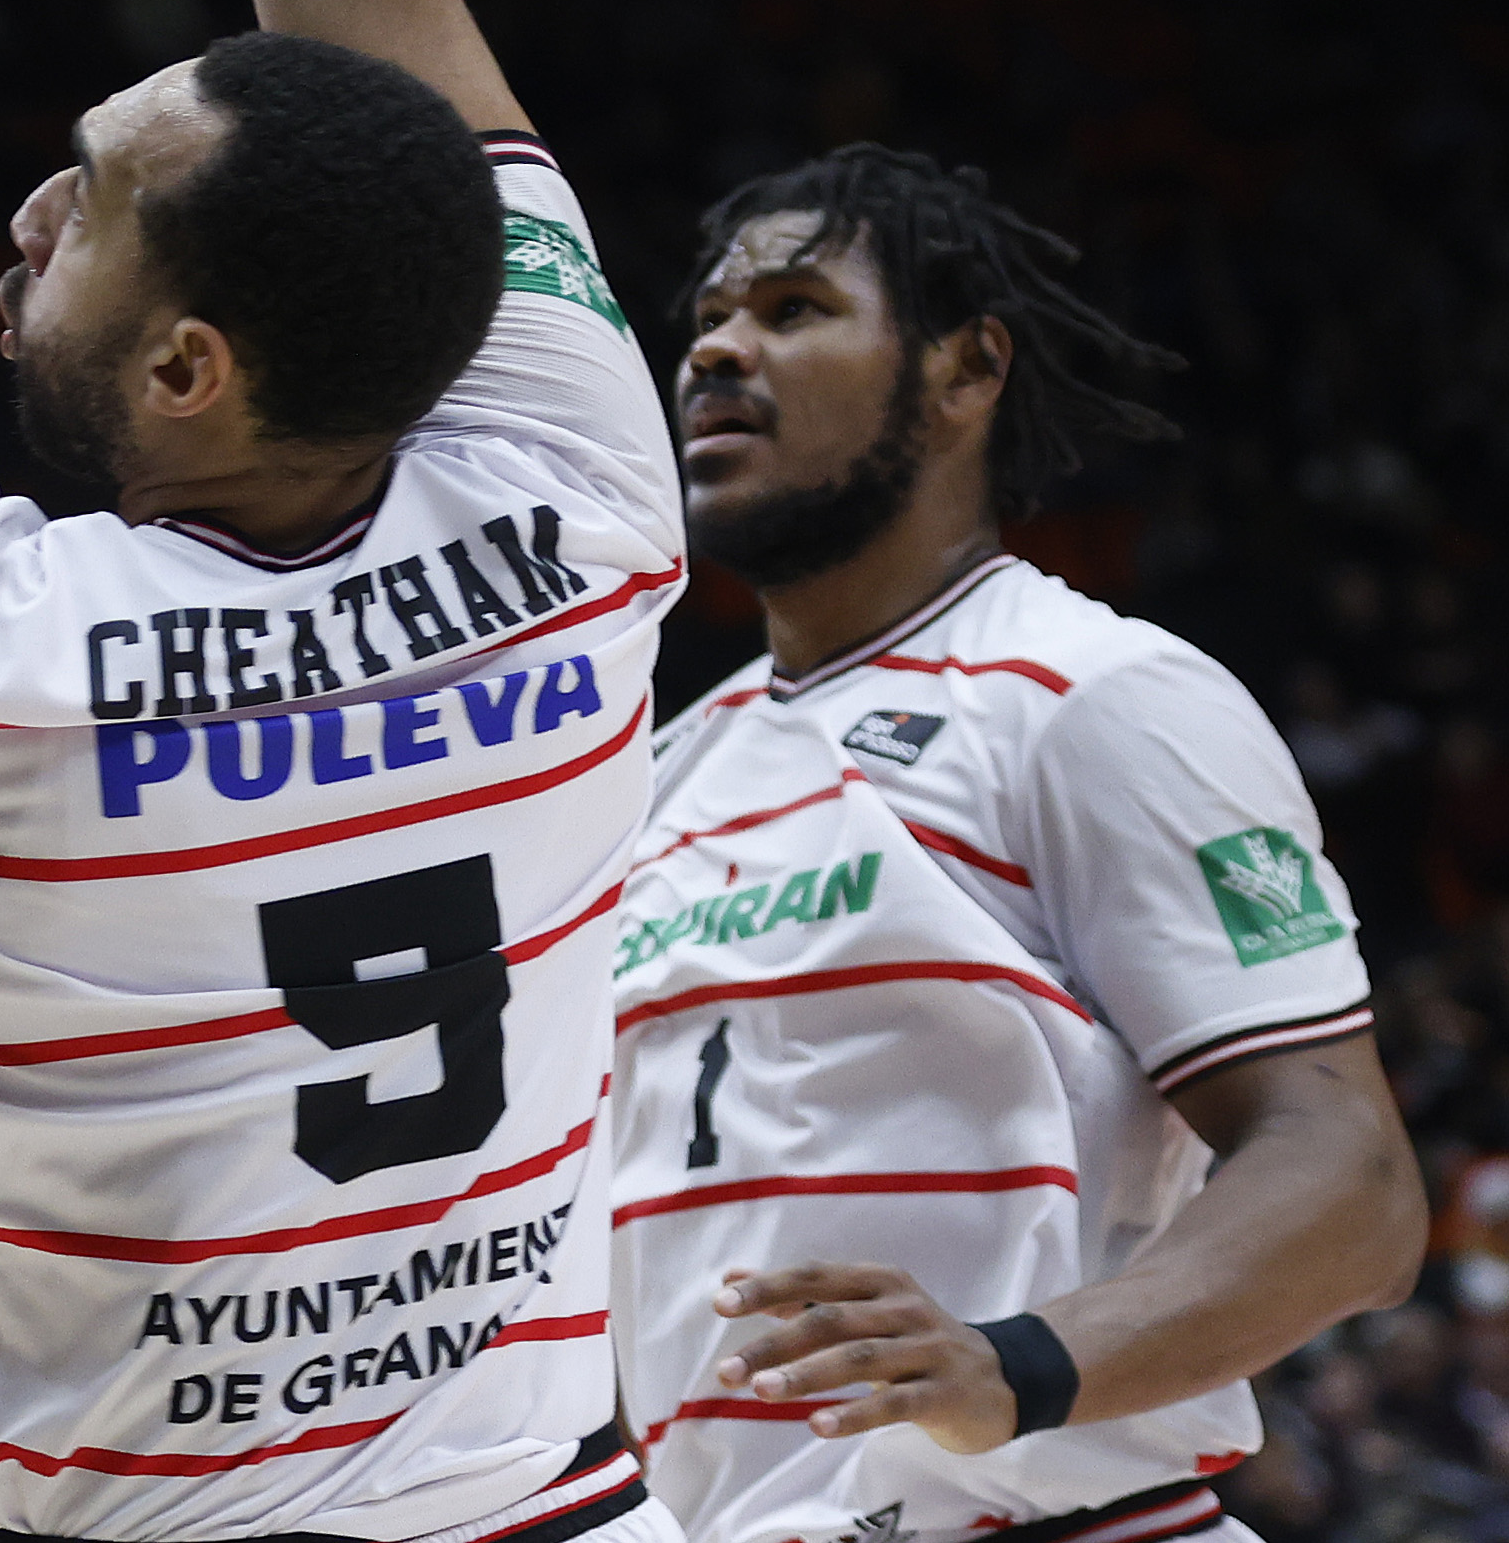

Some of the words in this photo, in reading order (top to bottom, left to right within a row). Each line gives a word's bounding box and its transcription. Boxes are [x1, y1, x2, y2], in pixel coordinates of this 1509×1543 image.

[87, 504, 589, 720] CHEATHAM
[96, 654, 602, 818] PULEVA
[259, 853, 509, 1185] 9
[168, 1373, 263, 1424] DE
